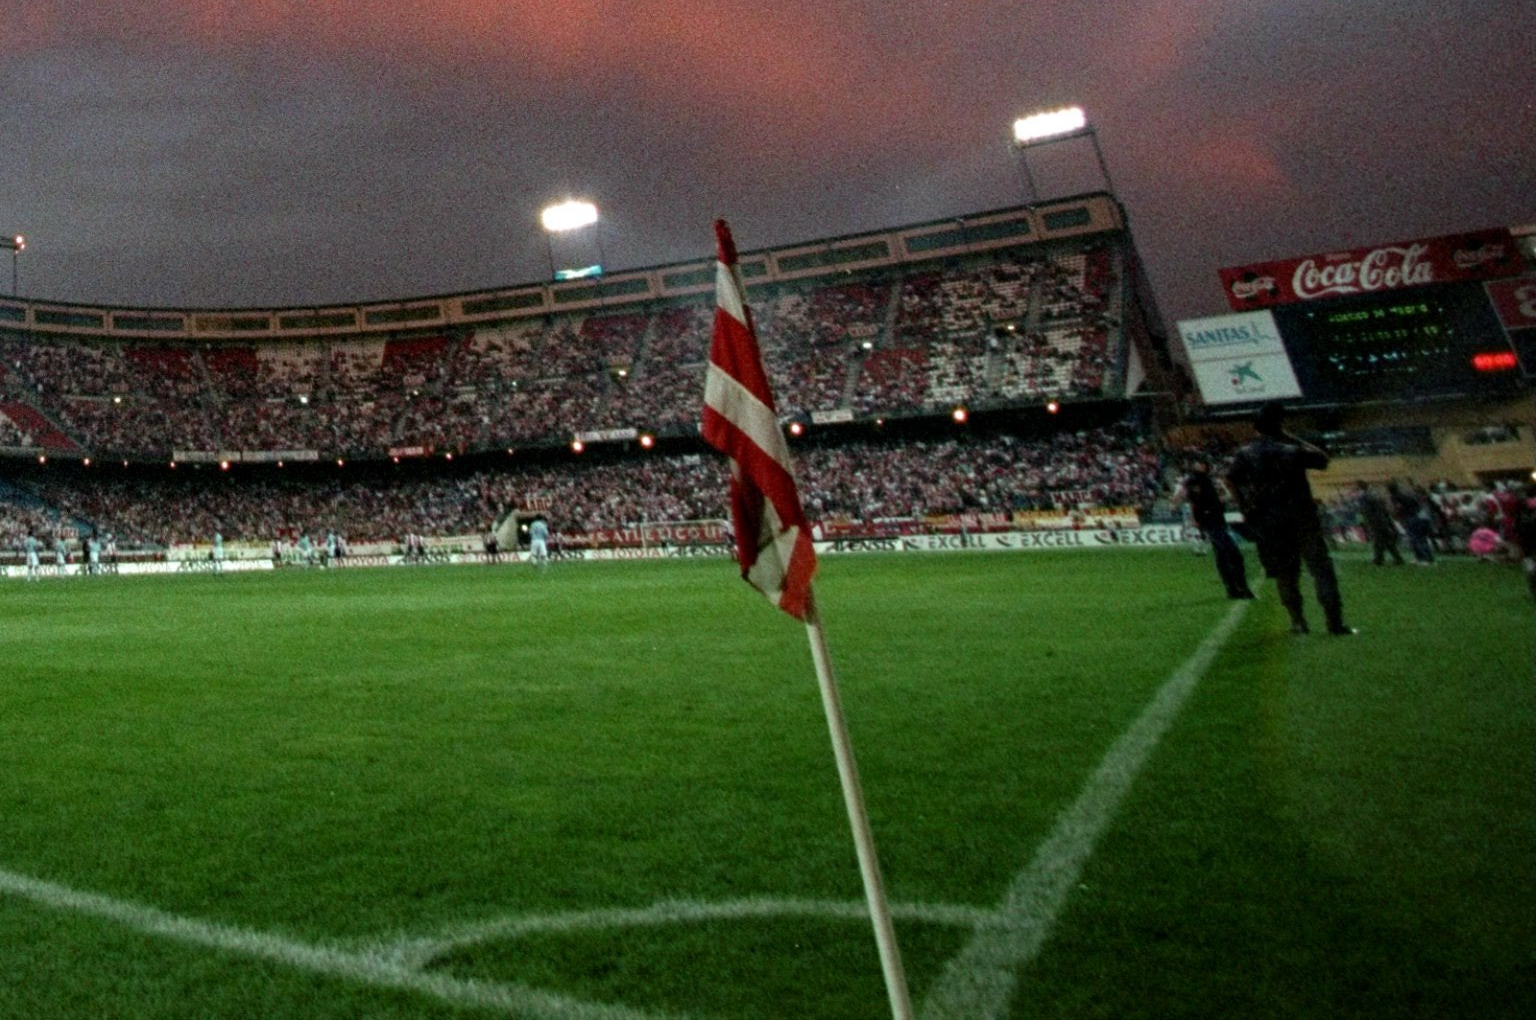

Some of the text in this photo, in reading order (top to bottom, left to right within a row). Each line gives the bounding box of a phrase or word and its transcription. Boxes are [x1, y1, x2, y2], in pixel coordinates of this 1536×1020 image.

[1292, 243, 1434, 299] Coca-Cola
[1186, 326, 1250, 345] SANITAS
[1021, 532, 1084, 547] EXCELL
